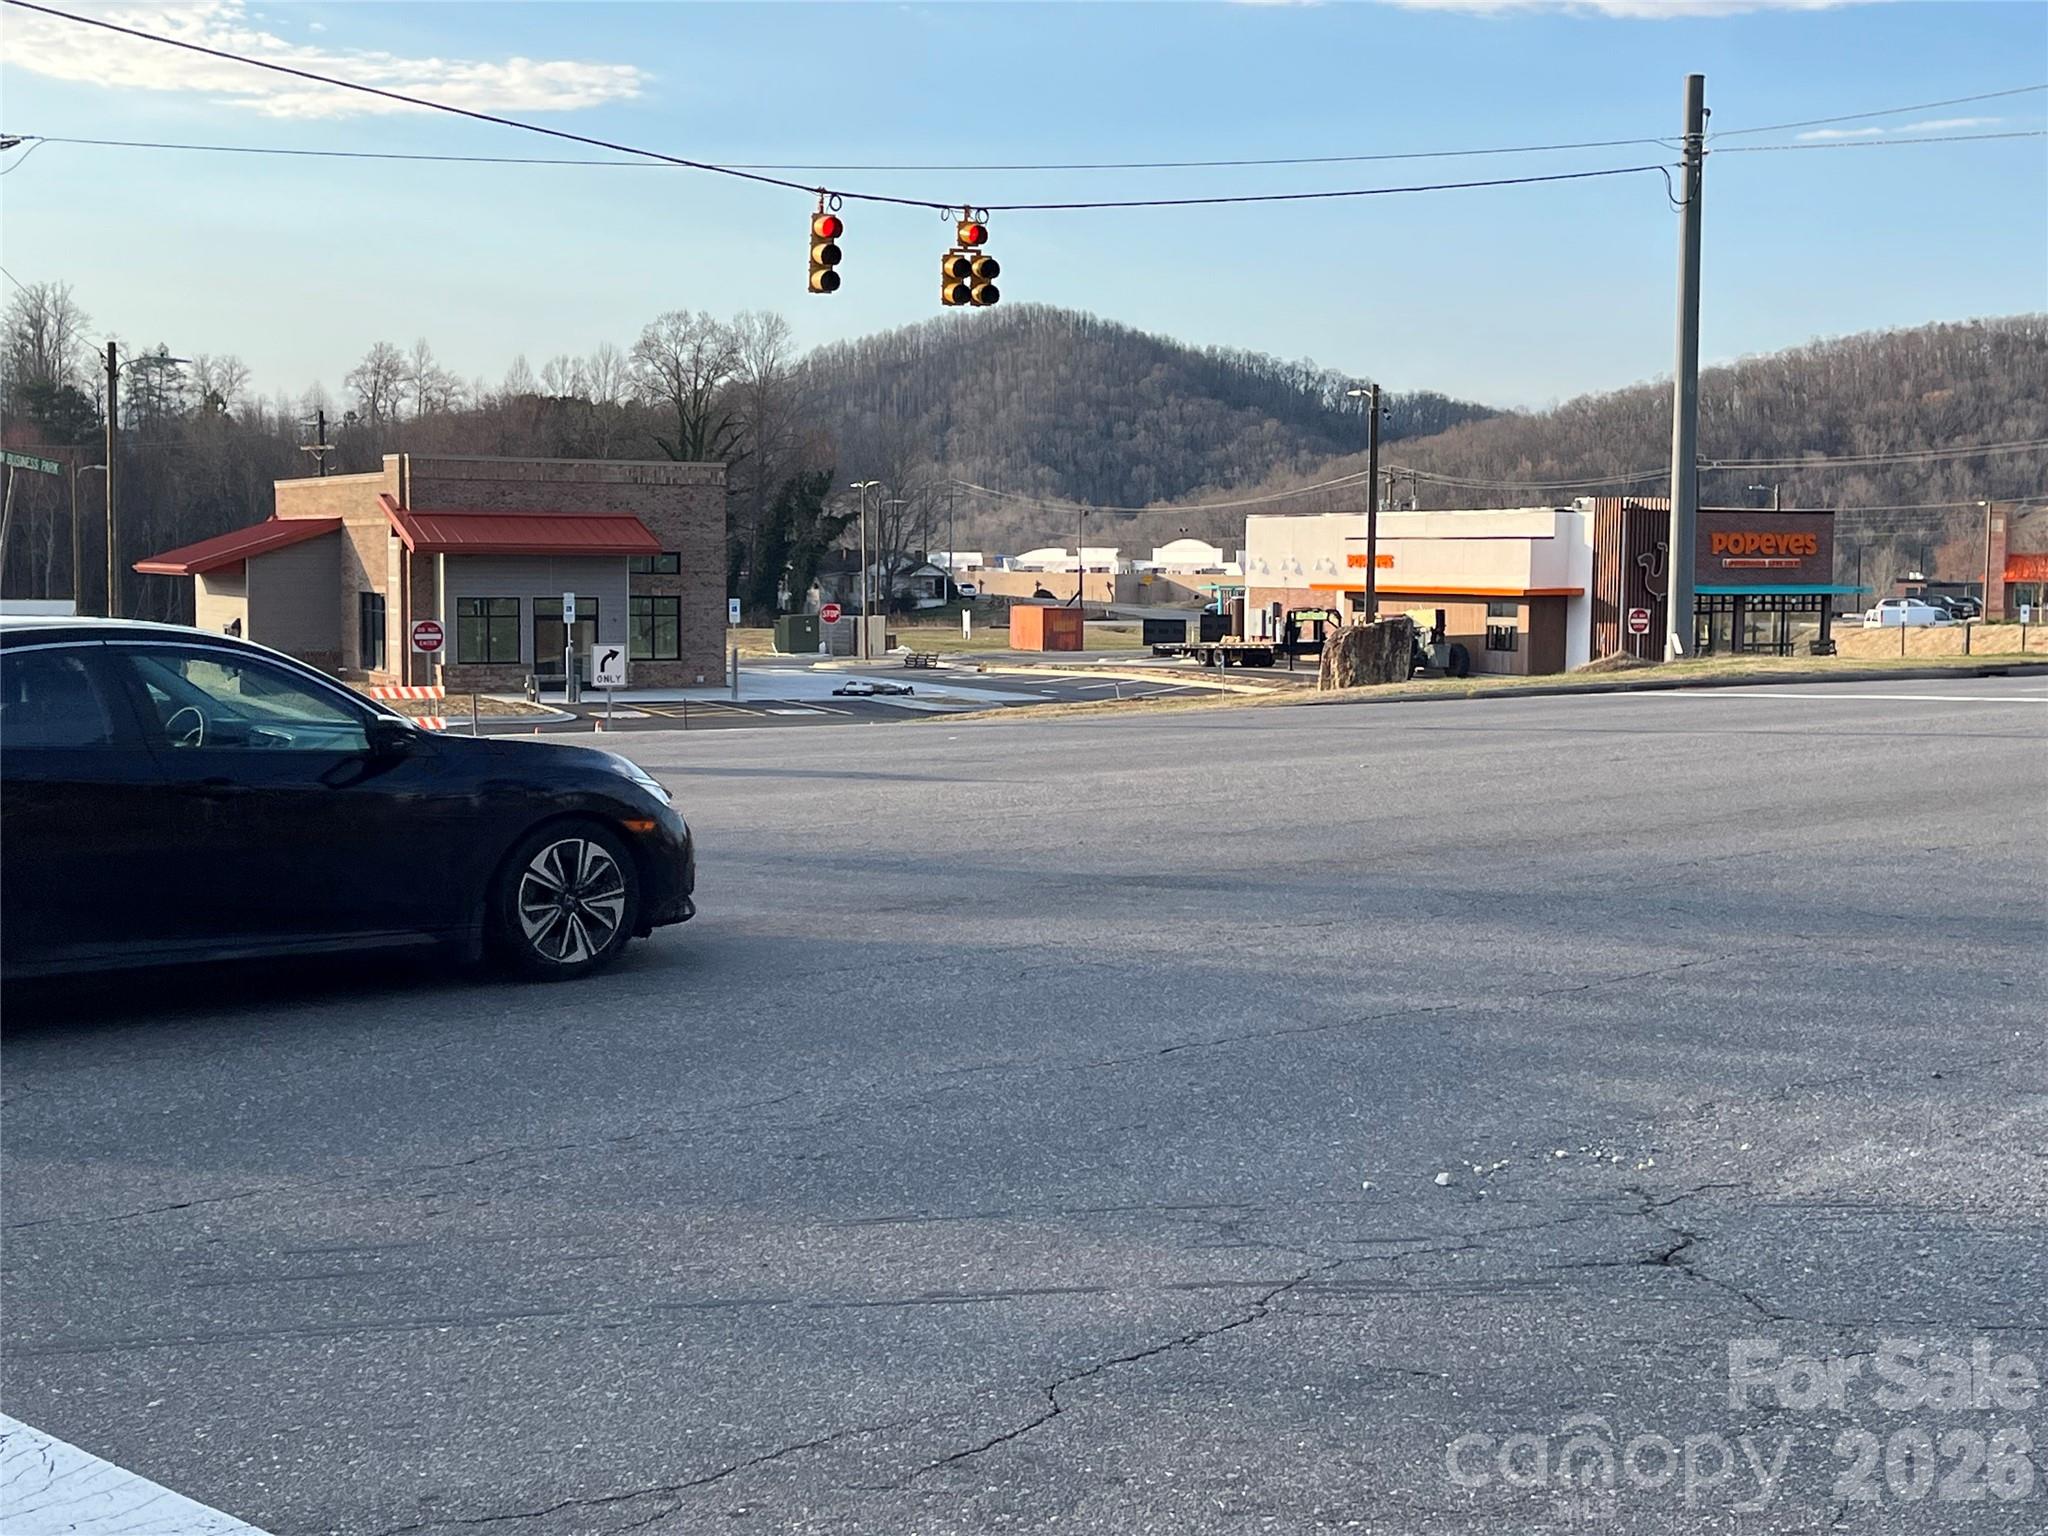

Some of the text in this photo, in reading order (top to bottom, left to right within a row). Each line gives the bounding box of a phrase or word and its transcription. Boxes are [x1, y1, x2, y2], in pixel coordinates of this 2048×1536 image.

[1346, 554, 1394, 568] POPYES
[822, 610, 839, 618] STOP
[596, 674, 622, 684] ONLY
